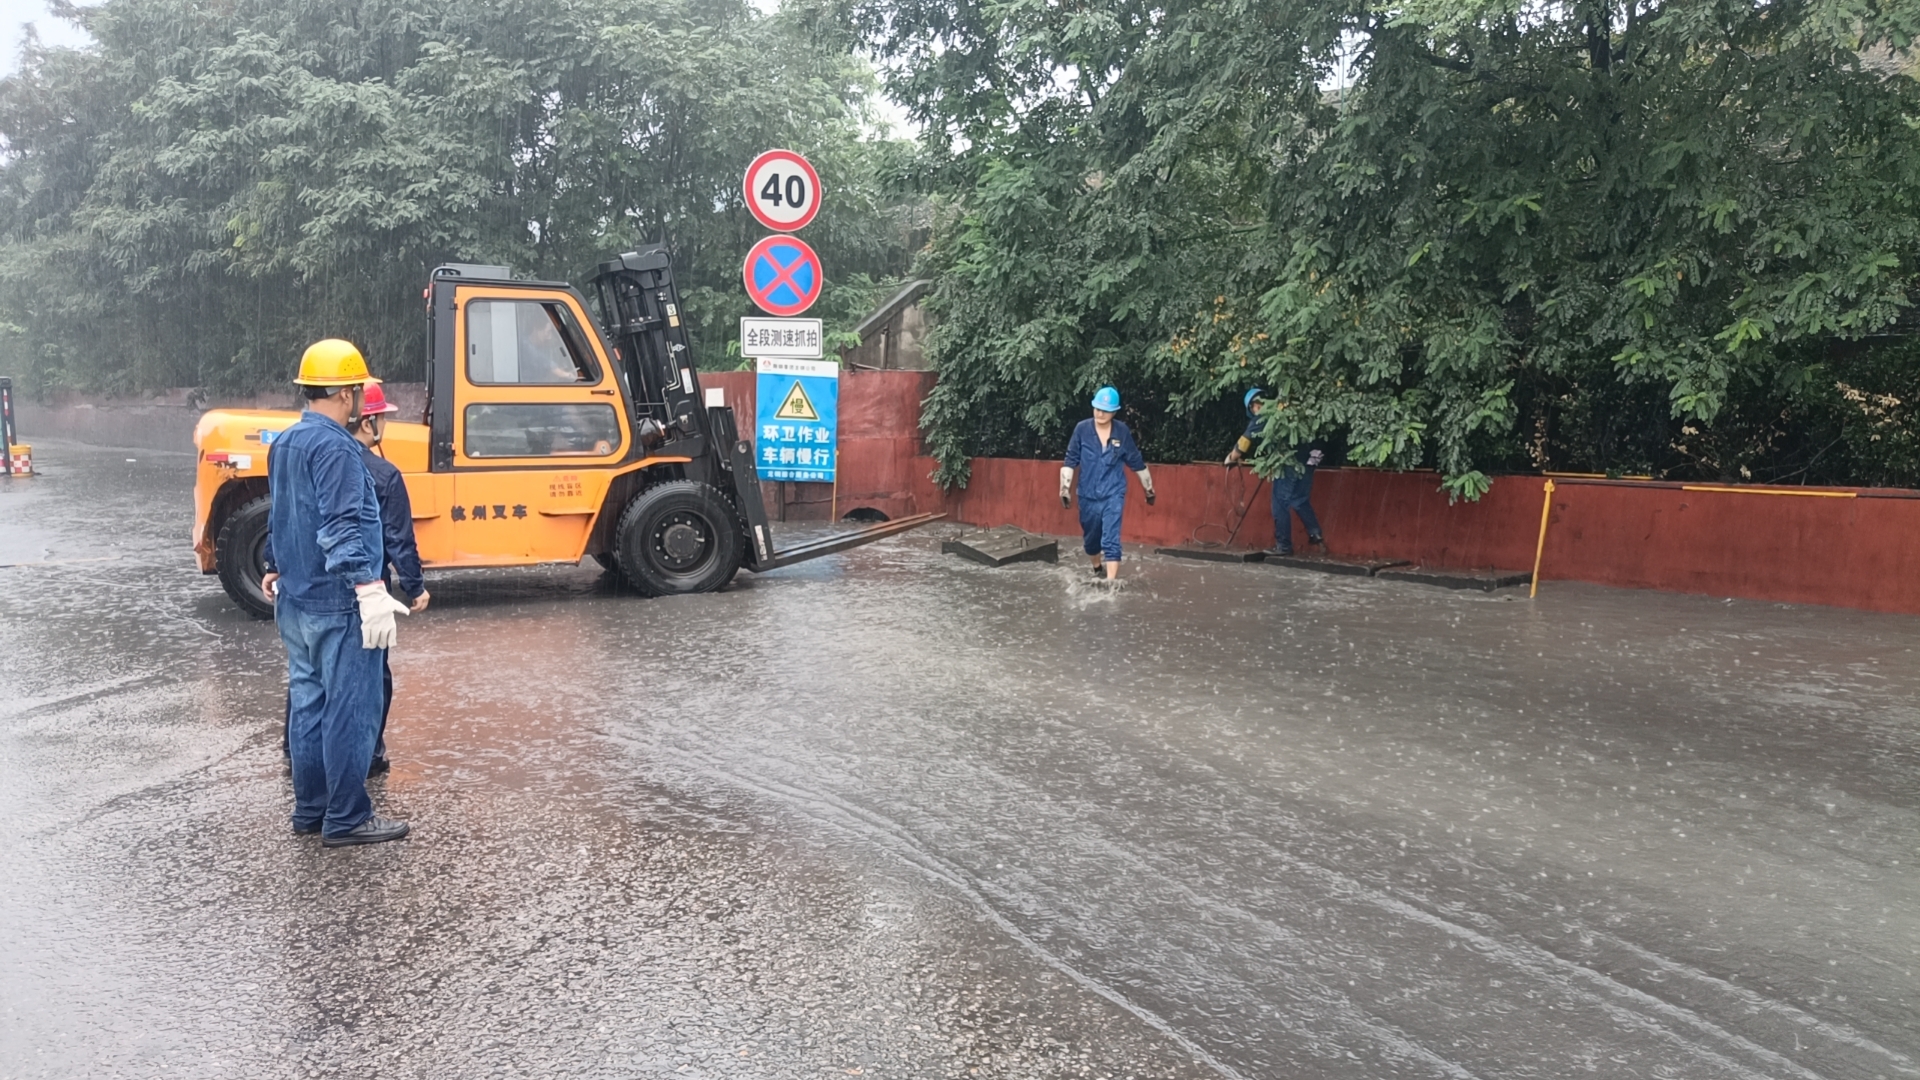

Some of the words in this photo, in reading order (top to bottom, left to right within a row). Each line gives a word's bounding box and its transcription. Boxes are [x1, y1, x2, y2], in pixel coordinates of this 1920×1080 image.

[761, 173, 805, 208] 40
[747, 328, 817, 347] 全段测速抓拍
[790, 398, 804, 414] 慢
[763, 425, 830, 443] 环卫作业
[762, 446, 830, 465] 车辆慢行
[451, 504, 527, 522] 杭州叉车
